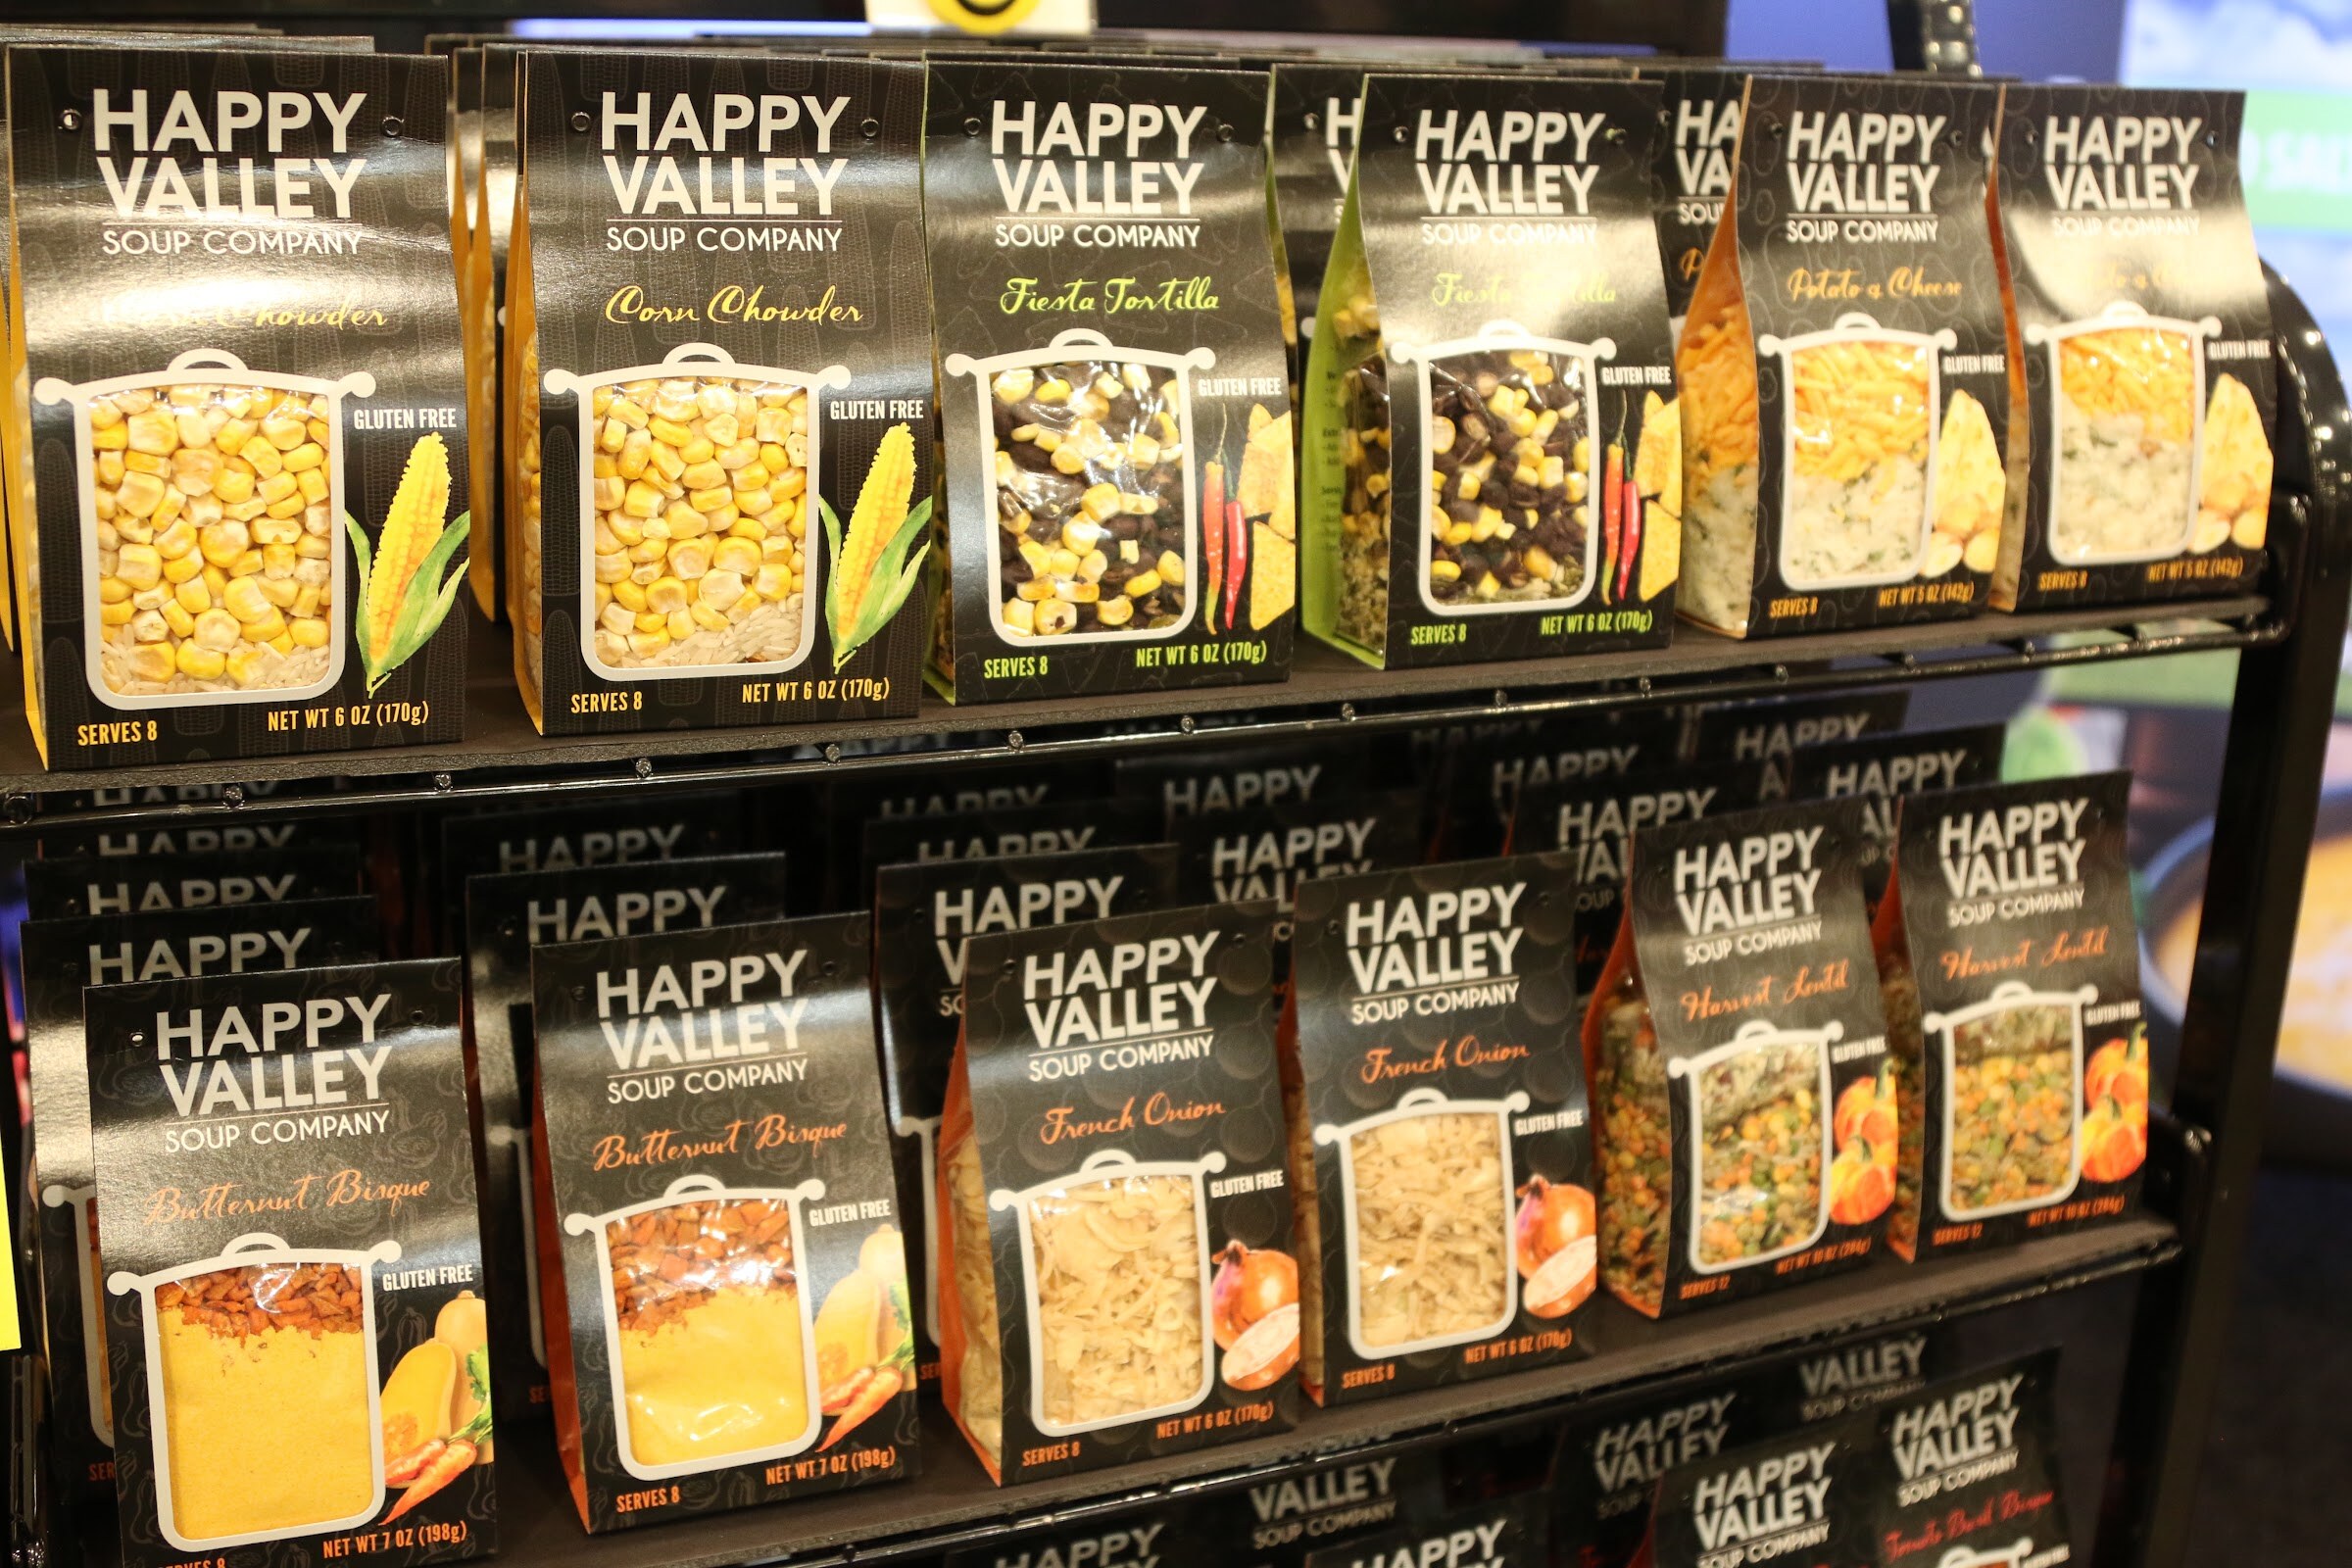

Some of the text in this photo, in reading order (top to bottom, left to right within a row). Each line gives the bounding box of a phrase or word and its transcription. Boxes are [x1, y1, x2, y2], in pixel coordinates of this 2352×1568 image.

[93, 89, 368, 153] HAPPY
[601, 91, 851, 153] HAPPY
[992, 100, 1208, 159] HAPPY
[1415, 109, 1606, 163] HAPPY
[1787, 111, 1947, 165] HAPPY
[2044, 116, 2202, 165] HAPPY
[96, 157, 368, 219] VALLEY
[603, 155, 850, 216] VALLEY
[992, 158, 1204, 215] VALLEY
[1415, 164, 1600, 215] VALLEY
[1787, 162, 1940, 214] VALLEY
[2045, 164, 2200, 210] VALLEY
[102, 230, 363, 255] SOUP COMPANY
[606, 226, 843, 252] SOUP COMPANY
[995, 223, 1200, 247] SOUP COMPANY
[1421, 223, 1597, 245] SOUP COMPANY
[1787, 220, 1939, 243] SOUP COMPANY
[605, 285, 863, 322] Corn Chowder
[1000, 275, 1219, 314] Fiesta Tortilla
[1942, 354, 2005, 374] GLUTEN FREE
[2249, 340, 2271, 358] FREE
[1198, 377, 1282, 397] GLUTEN FREE
[1601, 366, 1671, 385] GLUTEN FREE
[354, 409, 456, 430] GLUTEN FREE
[830, 400, 924, 420] GLUTEN FREE
[1410, 623, 1467, 646] SERVES 8
[1541, 610, 1653, 635] NET WT 6 OZ (170g)
[984, 656, 1049, 679] SERVES 8
[1136, 640, 1267, 667] NET WT 6 OZ (170g)
[570, 691, 642, 713] SERVES 8
[742, 676, 890, 703] NET WT 6 OZ (170g)
[77, 720, 158, 747] SERVES 8
[268, 701, 429, 732] NET WT 6 OZ (170g)
[1165, 764, 1322, 816] HAPPY
[1827, 749, 1967, 800] HAPPY
[1558, 787, 1717, 844] HAPPY
[1939, 798, 2089, 857] HAPPY
[499, 824, 684, 874] HAPPY
[1212, 818, 1377, 877] HAPPY
[1674, 827, 1824, 893] HAPPY
[1940, 839, 2086, 898] VALLEY
[527, 886, 727, 943] HAPPY
[935, 876, 1124, 937] HAPPY
[1347, 883, 1527, 947] HAPPY
[1676, 870, 1822, 936] VALLEY
[1947, 888, 2084, 927] SOUP COMPANY
[89, 928, 312, 985] HAPPY
[1023, 931, 1220, 1000] HAPPY
[1348, 928, 1525, 995] VALLEY
[1684, 920, 1822, 966] SOUP COMPANY
[596, 950, 808, 1018] HAPPY
[1351, 983, 1520, 1025] SOUP COMPANY
[156, 993, 391, 1060] HAPPY
[600, 998, 808, 1070] VALLEY
[1024, 977, 1218, 1049] VALLEY
[159, 1046, 392, 1116] VALLEY
[607, 1058, 808, 1103] SOUP COMPANY
[1029, 1035, 1214, 1083] SOUP COMPANY
[1360, 1035, 1531, 1084] French Onion
[165, 1109, 390, 1153] SOUP COMPANY
[592, 1113, 848, 1172] Butternut Bisque
[1040, 1091, 1226, 1145] French Onion
[1515, 1109, 1584, 1136] GLUTEN FREE
[143, 1169, 432, 1225] Butternut Bisque
[1210, 1169, 1284, 1199] GLUTEN FREE
[808, 1199, 891, 1227] GLUTEN FREE
[382, 1264, 473, 1292] GLUTEN FREE
[1800, 1337, 1929, 1396] VALLEY
[1156, 1402, 1274, 1439] NET WT 6 OZ (170g)
[1595, 1392, 1737, 1459] HAPPY
[1892, 1373, 2025, 1446] HAPPY
[765, 1446, 897, 1486] NET WT 7 OZ (198g)
[1022, 1442, 1080, 1467] SERVES 8
[1893, 1405, 2021, 1481] VALLEY
[616, 1486, 680, 1513] SERVES 8
[1249, 1457, 1399, 1521] VALLEY
[1693, 1442, 1837, 1513] HAPPY
[1251, 1514, 1303, 1549] SOUP
[1693, 1476, 1834, 1551] VALLEY
[322, 1521, 466, 1559] NET WT 7 OZ (198g)
